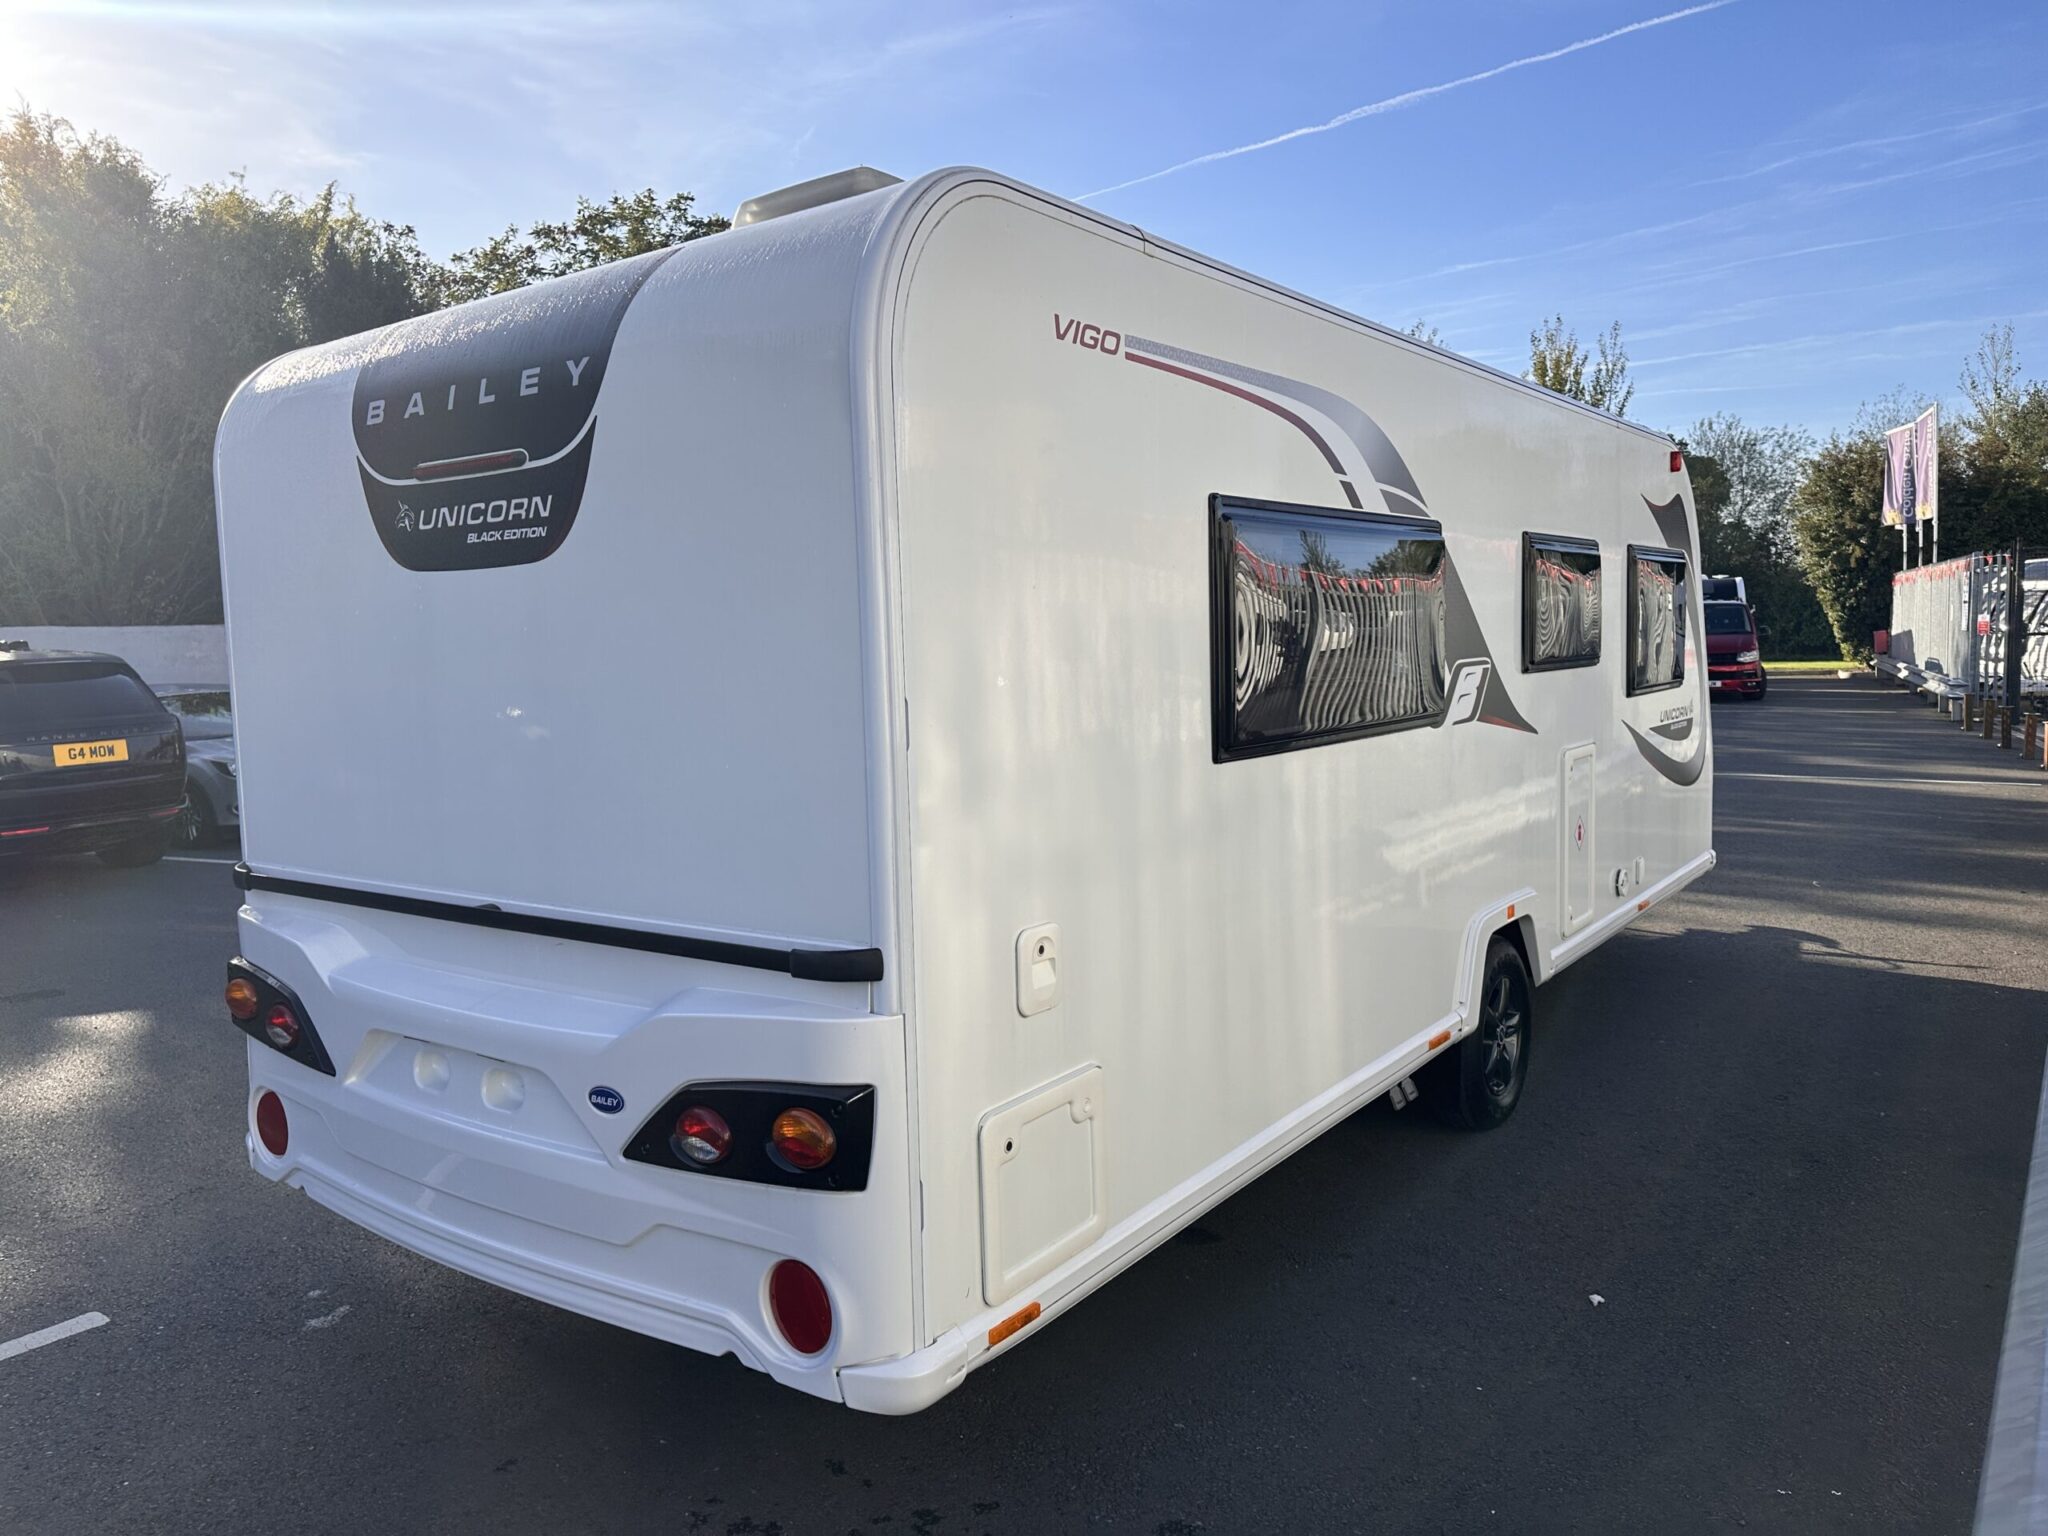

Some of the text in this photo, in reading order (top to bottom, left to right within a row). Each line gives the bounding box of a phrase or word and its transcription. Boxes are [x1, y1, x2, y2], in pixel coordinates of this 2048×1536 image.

[1054, 313, 1121, 356] VIGO
[366, 356, 590, 426] BAILEY
[418, 494, 553, 530] UNICORN
[467, 526, 548, 544] BLACK EDITION
[1660, 705, 1688, 723] UNICORN
[68, 744, 115, 760] G4 MOW
[590, 1093, 619, 1107] BAILEY
